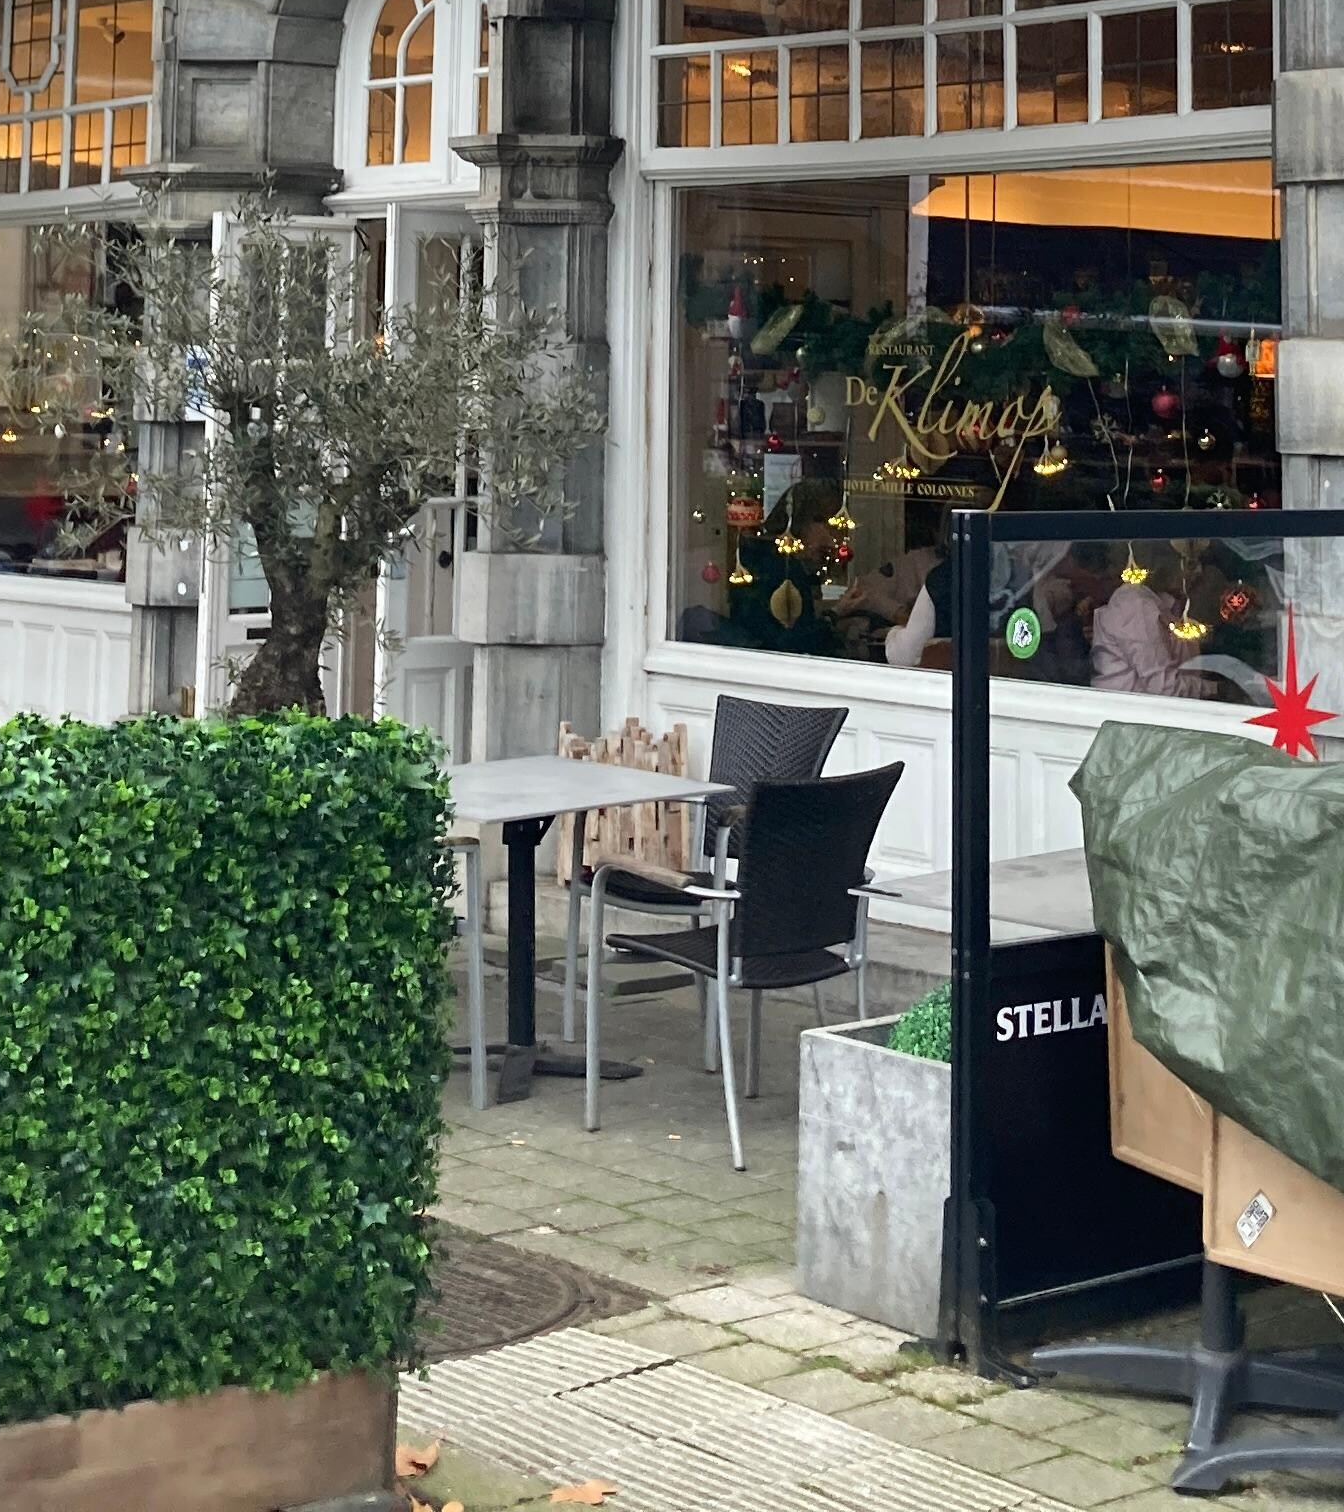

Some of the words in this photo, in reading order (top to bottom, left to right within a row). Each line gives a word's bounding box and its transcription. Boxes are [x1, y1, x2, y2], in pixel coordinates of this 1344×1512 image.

[867, 343, 935, 357] RESTAURANT
[844, 376, 878, 406] De
[867, 328, 1063, 513] Klimop
[917, 484, 976, 497] COLONNES
[996, 993, 1109, 1042] STELLA
